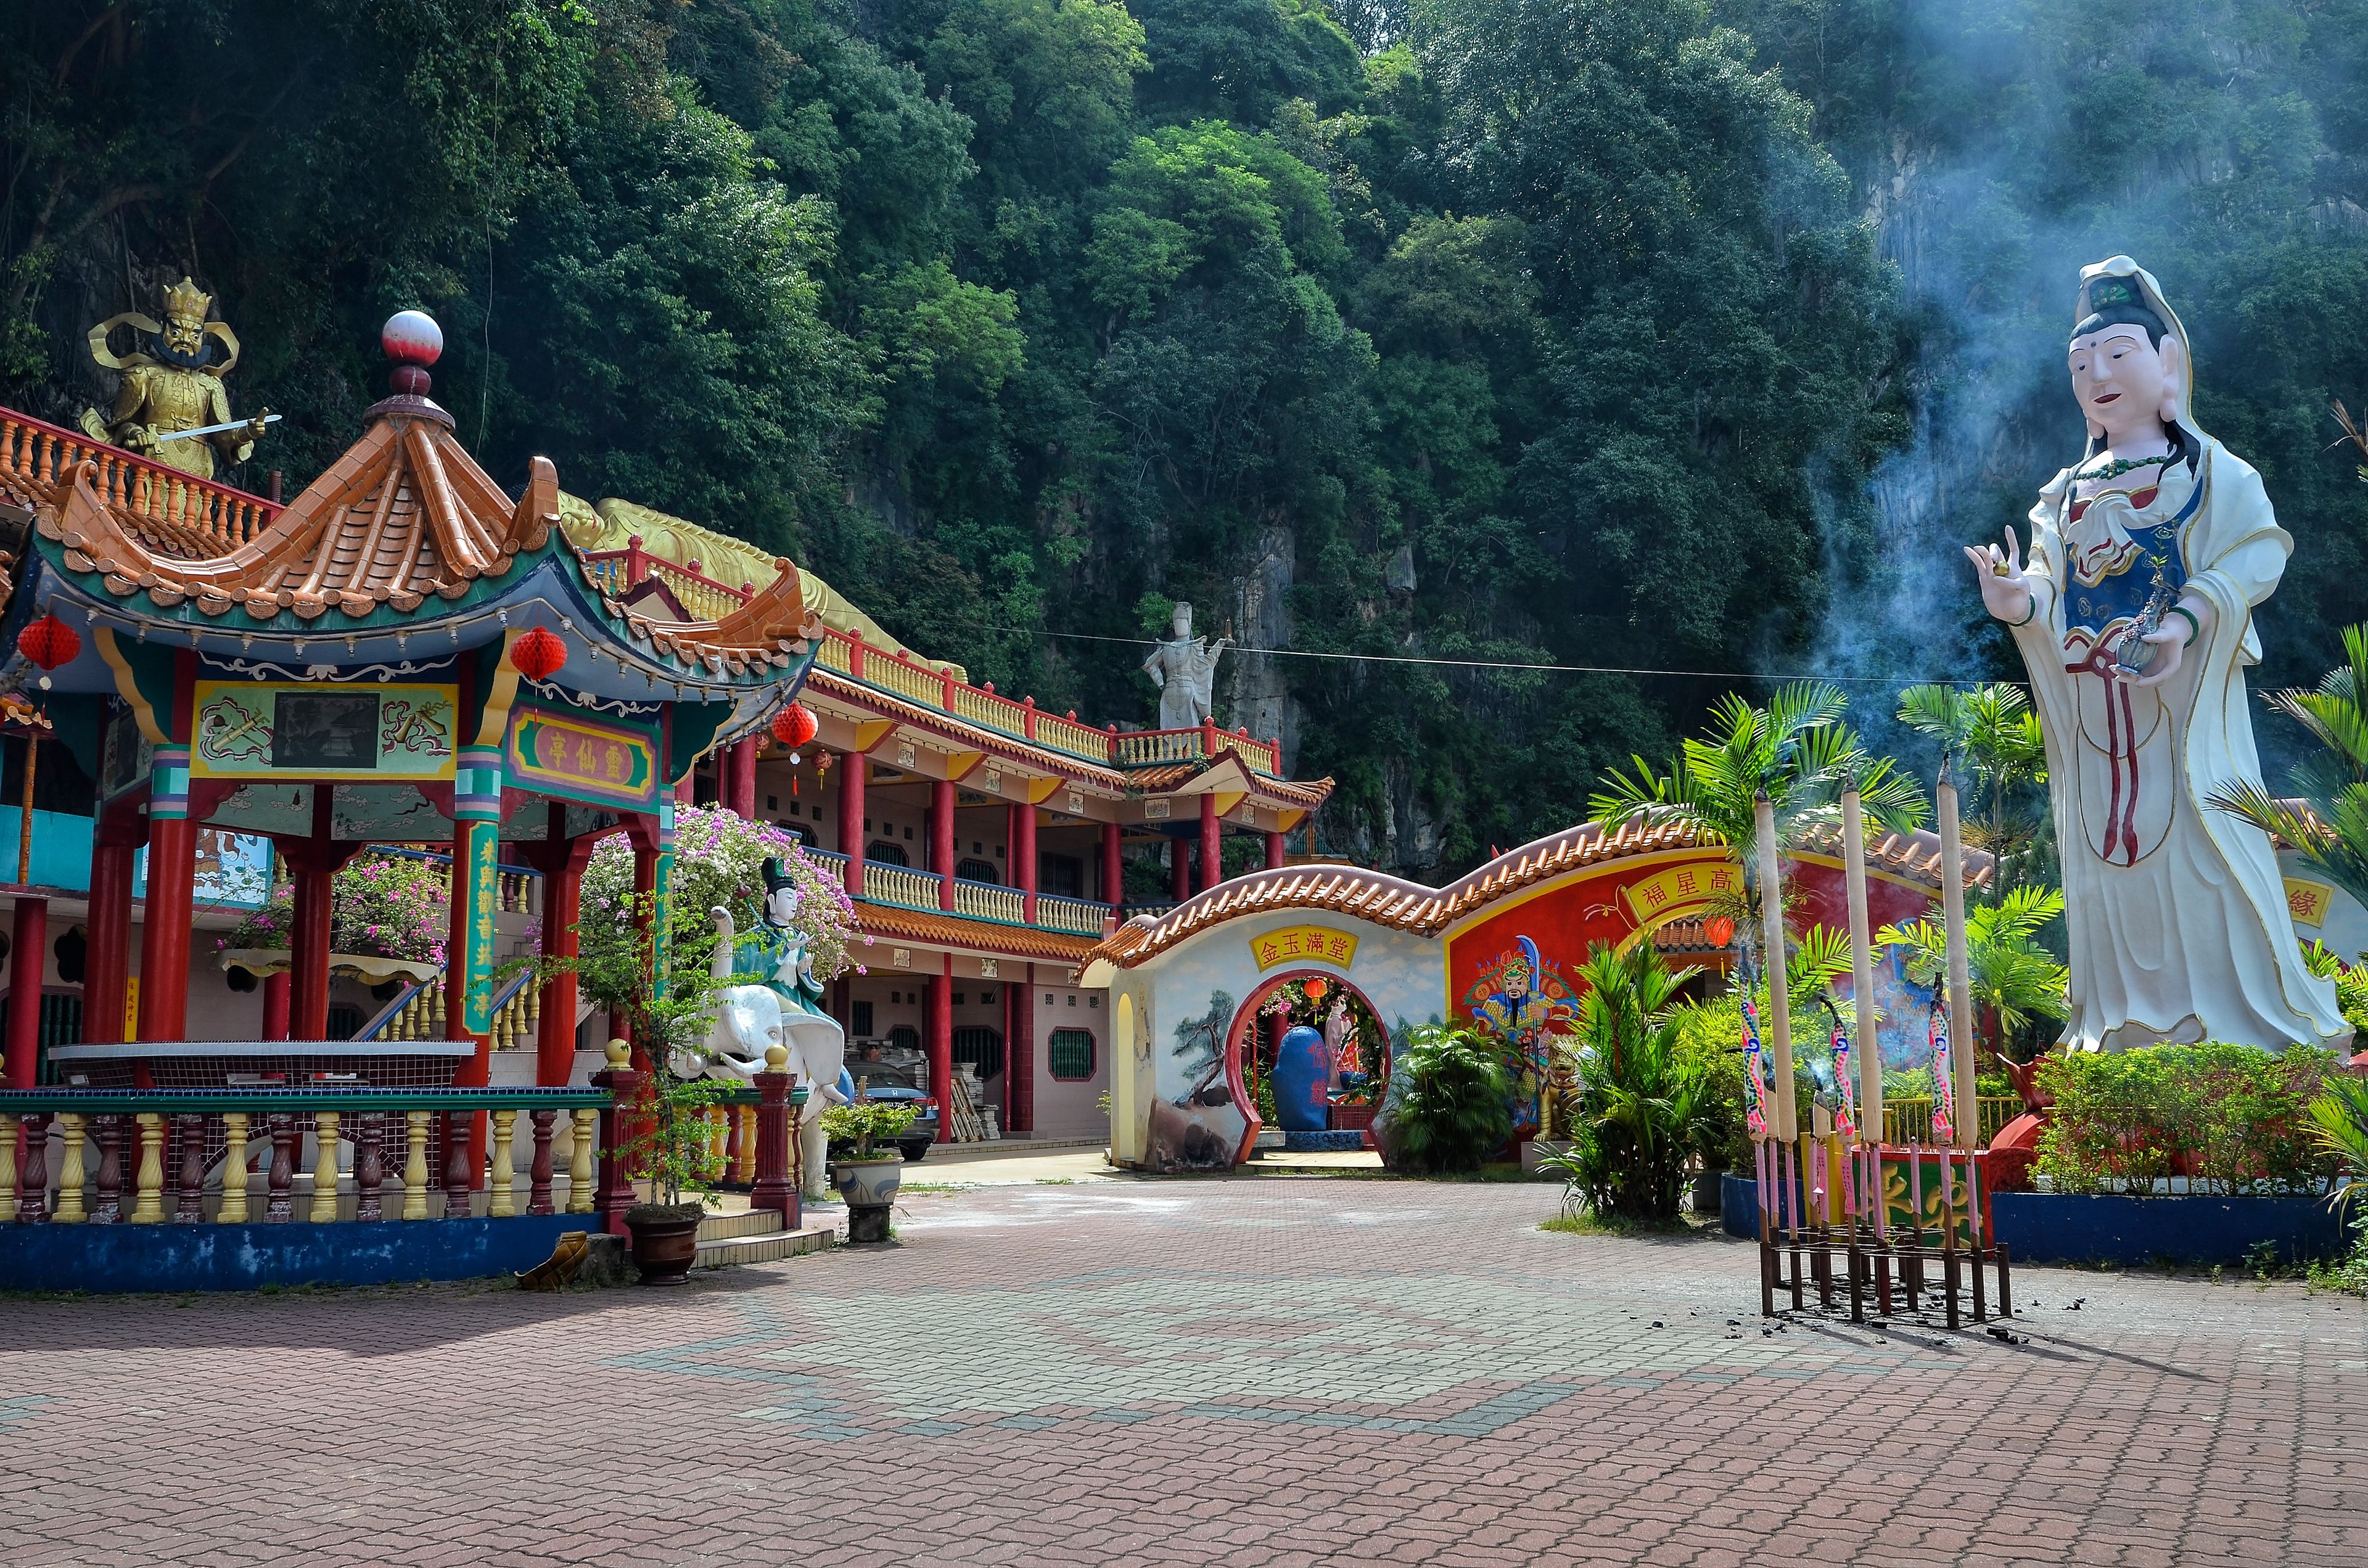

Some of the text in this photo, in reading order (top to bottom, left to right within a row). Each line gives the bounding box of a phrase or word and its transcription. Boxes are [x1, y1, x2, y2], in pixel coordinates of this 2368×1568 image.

[1642, 868, 1748, 908] 福星高
[2288, 889, 2317, 917] 緣
[1260, 932, 1349, 964] 金玉滿堂
